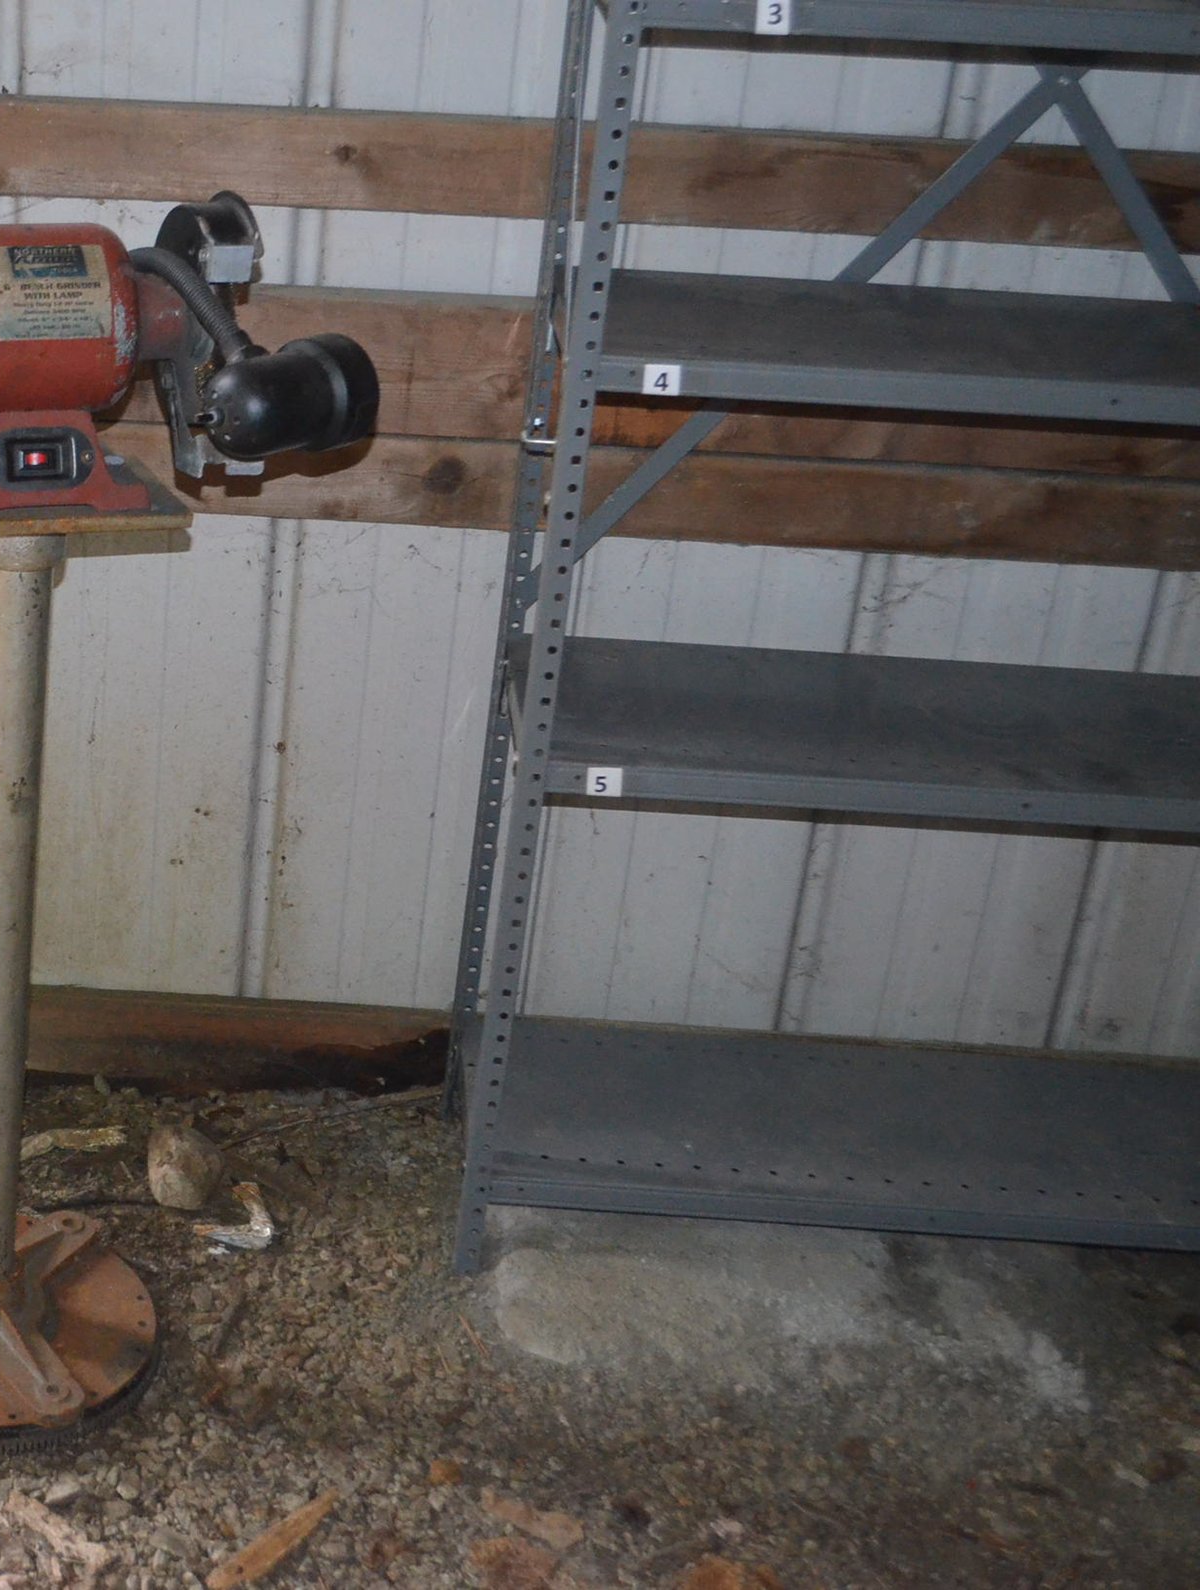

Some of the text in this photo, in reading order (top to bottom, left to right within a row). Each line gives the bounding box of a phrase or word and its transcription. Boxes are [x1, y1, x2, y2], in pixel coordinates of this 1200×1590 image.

[767, 3, 782, 26] 3
[23, 291, 83, 300] WITH LAMP
[653, 372, 669, 392] 4
[594, 775, 607, 793] 5
